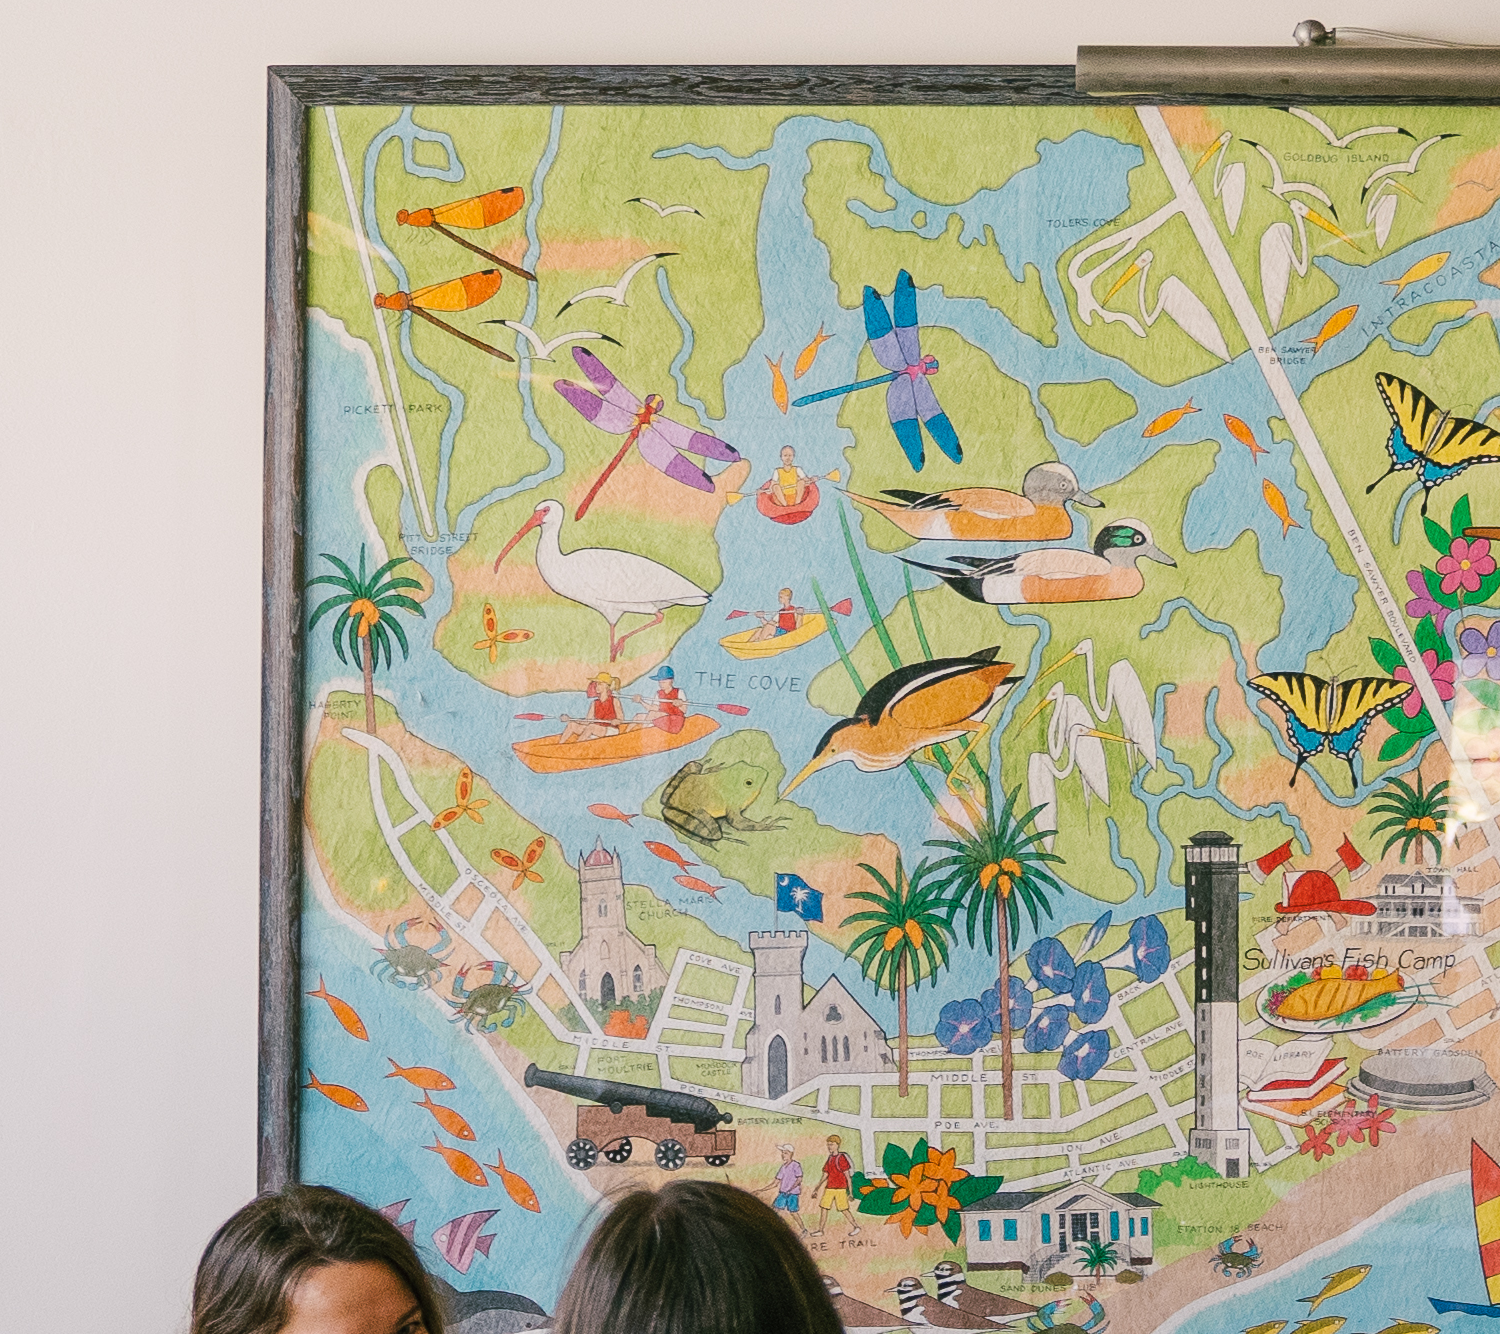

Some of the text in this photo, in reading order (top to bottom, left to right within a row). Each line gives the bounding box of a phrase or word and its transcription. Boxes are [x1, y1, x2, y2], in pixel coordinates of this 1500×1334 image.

[1283, 152, 1390, 164] GOLDBUG ISLAND
[1093, 217, 1121, 227] COVE
[1258, 346, 1277, 355] BEN
[1269, 356, 1307, 366] BRIDGE
[408, 403, 444, 414] PARK
[399, 532, 479, 543] PITT STREET
[410, 546, 453, 556] BRIDGE
[1347, 528, 1418, 665] BEN SAWYER BOULEVARD
[696, 671, 802, 693] THE COVE
[322, 710, 354, 720] POINT
[1425, 865, 1479, 874] TOWN HALL
[463, 867, 510, 913] OSCEOLA
[417, 882, 453, 921] MIDDLE
[625, 897, 672, 912] STELLA
[638, 907, 689, 922] CHURCH
[688, 952, 713, 966] COVE
[1242, 946, 1457, 979] Sullivan's Fish Camp
[1116, 984, 1142, 1002] BACK
[672, 995, 725, 1012] THOMPSON
[572, 1035, 630, 1050] MIDDLE
[1112, 1032, 1161, 1059] CENTRAL
[908, 1049, 952, 1059] THOMPS
[1245, 1048, 1316, 1063] POE LIBRARY
[1377, 1048, 1483, 1058] BATTERY GADSDEN
[597, 1054, 626, 1065] FORT
[598, 1062, 654, 1075] MOULTRIE
[700, 1068, 732, 1077] CASTLE
[1148, 1064, 1187, 1083] MIDDLE
[929, 1072, 989, 1084] MIDDLE
[679, 1083, 704, 1095] POE
[771, 1116, 804, 1126] JASPER
[934, 1120, 962, 1130] POE
[1060, 1143, 1083, 1154] ION
[1062, 1161, 1113, 1179] ATLANTIC
[1189, 1180, 1249, 1191] LIGHTHOUSE
[1246, 1222, 1284, 1233] BEACH
[838, 1239, 878, 1249] TRAIL
[999, 1283, 1026, 1294] SAND
